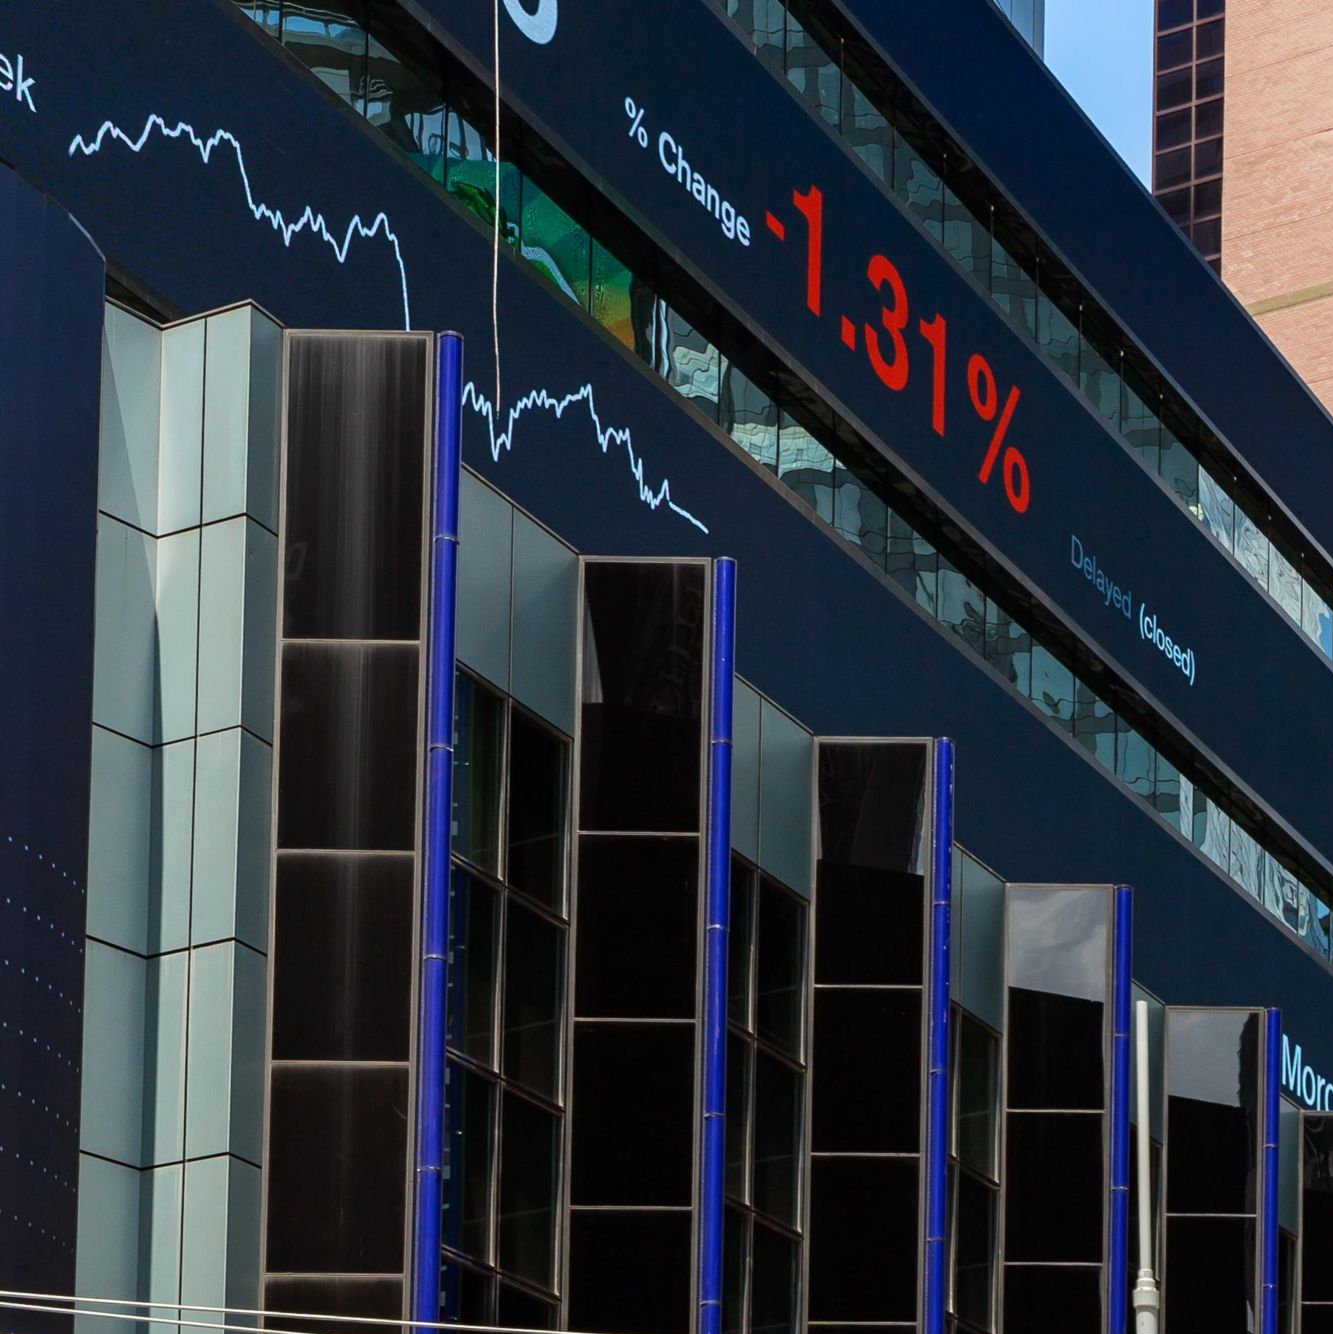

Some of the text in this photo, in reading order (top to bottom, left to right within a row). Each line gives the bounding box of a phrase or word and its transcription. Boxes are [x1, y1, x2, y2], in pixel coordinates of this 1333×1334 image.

[0, 53, 37, 113] ek
[658, 130, 751, 247] Change
[1070, 534, 1195, 685] Delayed (closed)
